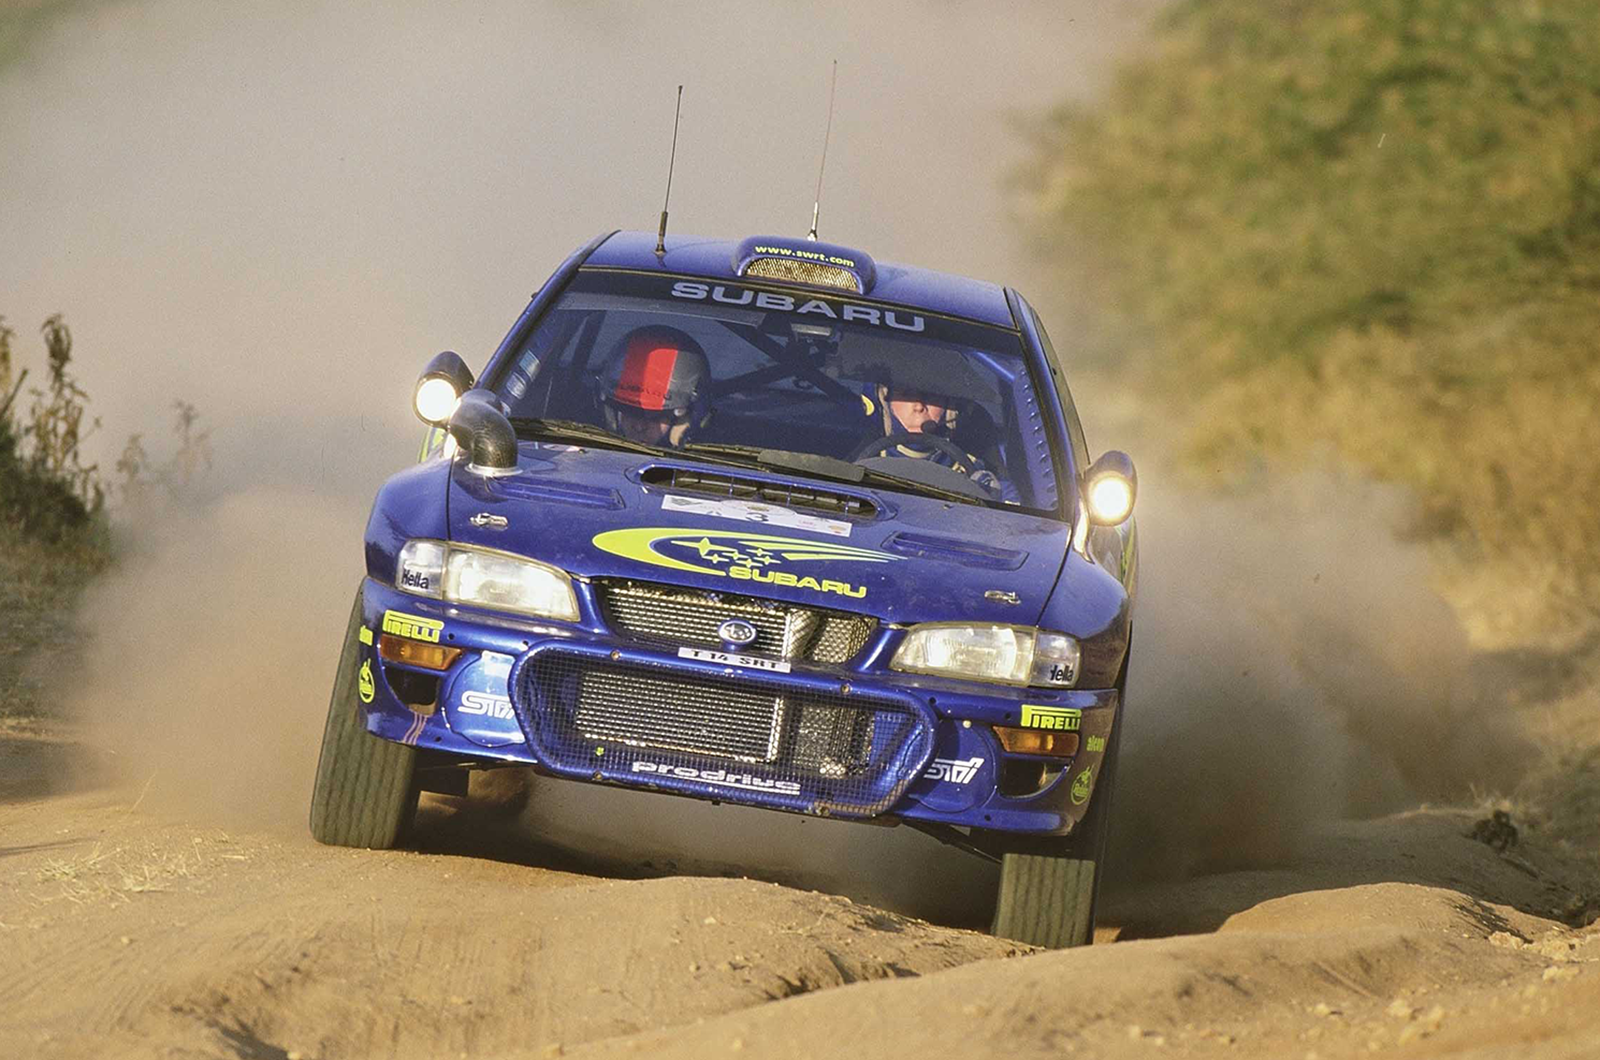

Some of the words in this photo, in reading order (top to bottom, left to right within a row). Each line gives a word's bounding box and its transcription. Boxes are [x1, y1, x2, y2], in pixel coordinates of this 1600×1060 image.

[755, 245, 854, 268] www.swrt.com
[671, 281, 925, 332] SUBARU
[401, 568, 429, 590] Hella
[729, 565, 867, 599] SUBARU
[382, 610, 445, 643] PIRELLI
[1021, 704, 1082, 731] PIRELLI
